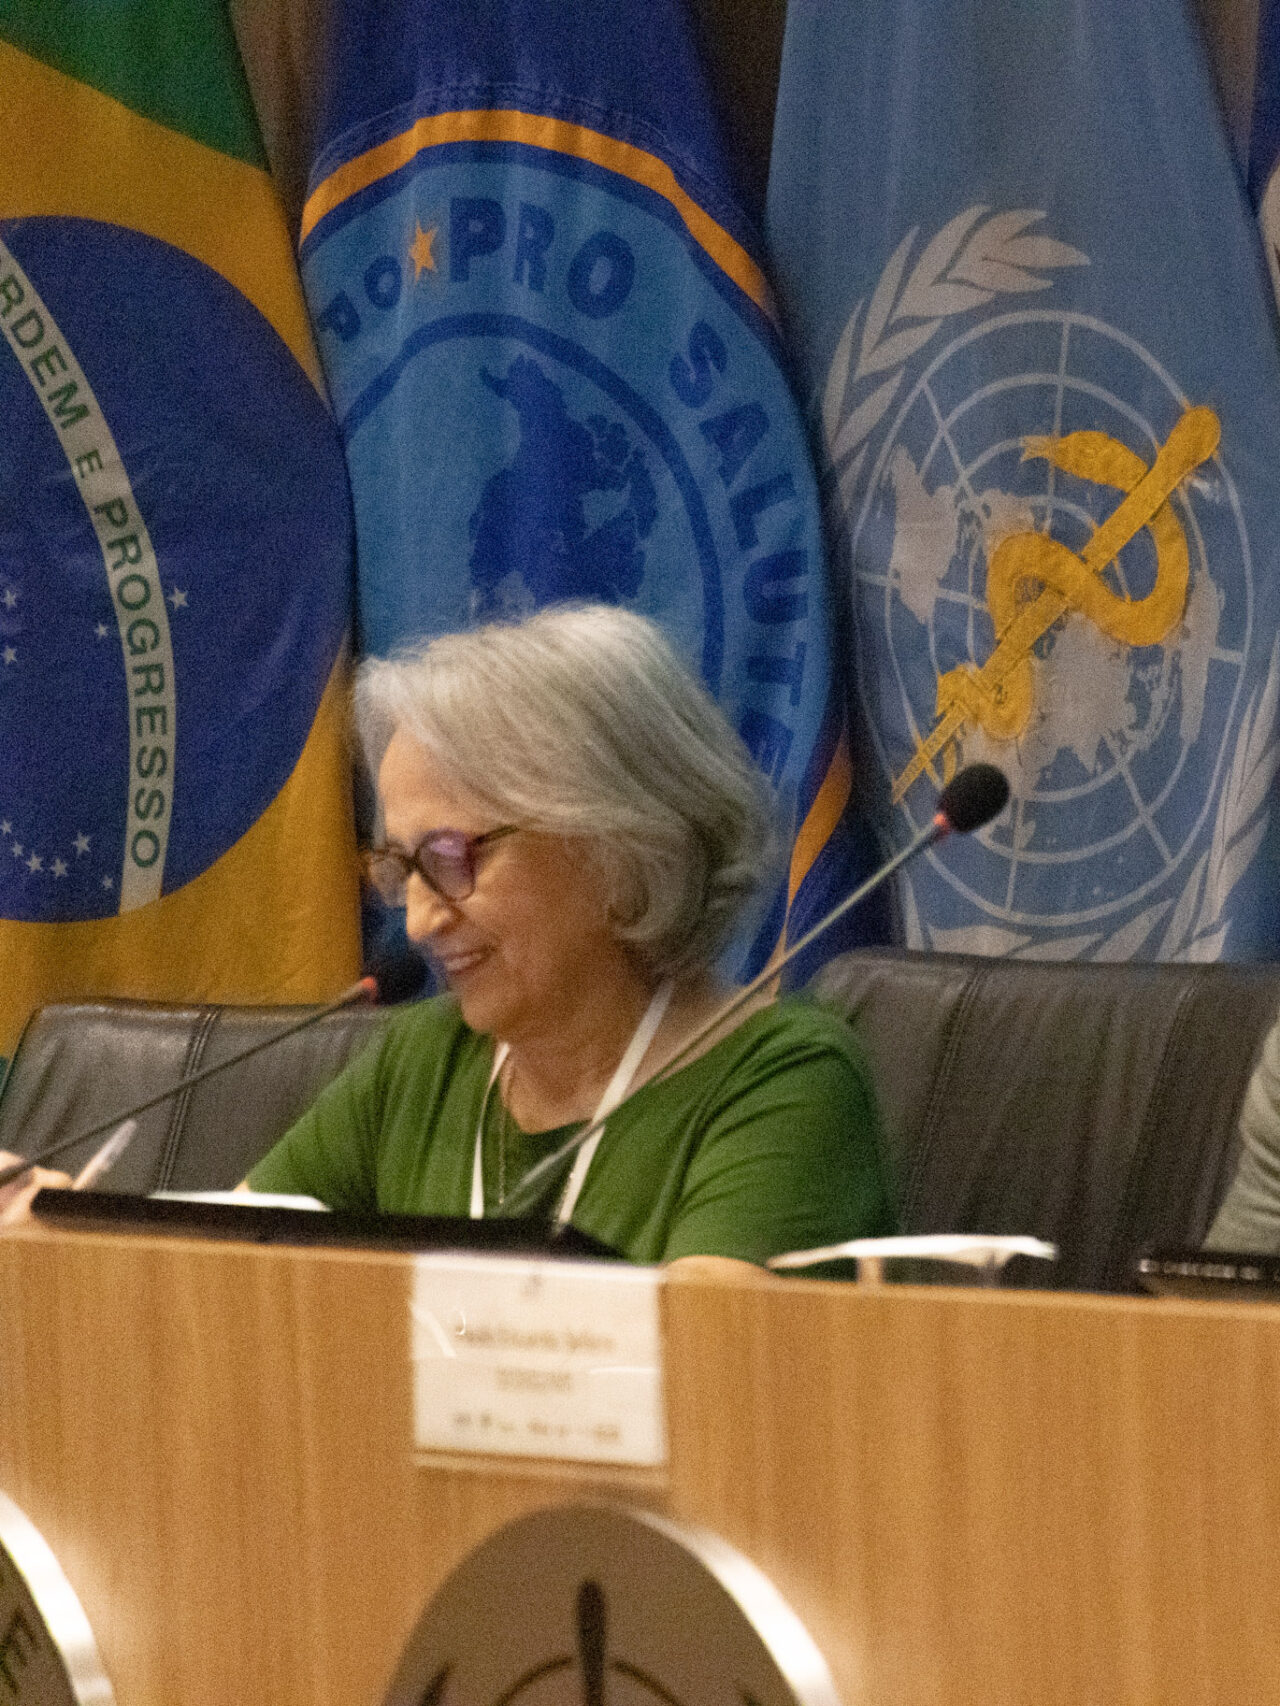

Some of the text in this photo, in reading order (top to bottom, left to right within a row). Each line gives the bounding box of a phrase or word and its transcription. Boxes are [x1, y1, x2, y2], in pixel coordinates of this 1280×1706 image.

[449, 197, 636, 320] PRO
[75, 450, 103, 478] E
[94, 497, 167, 868] PROGRESSO
